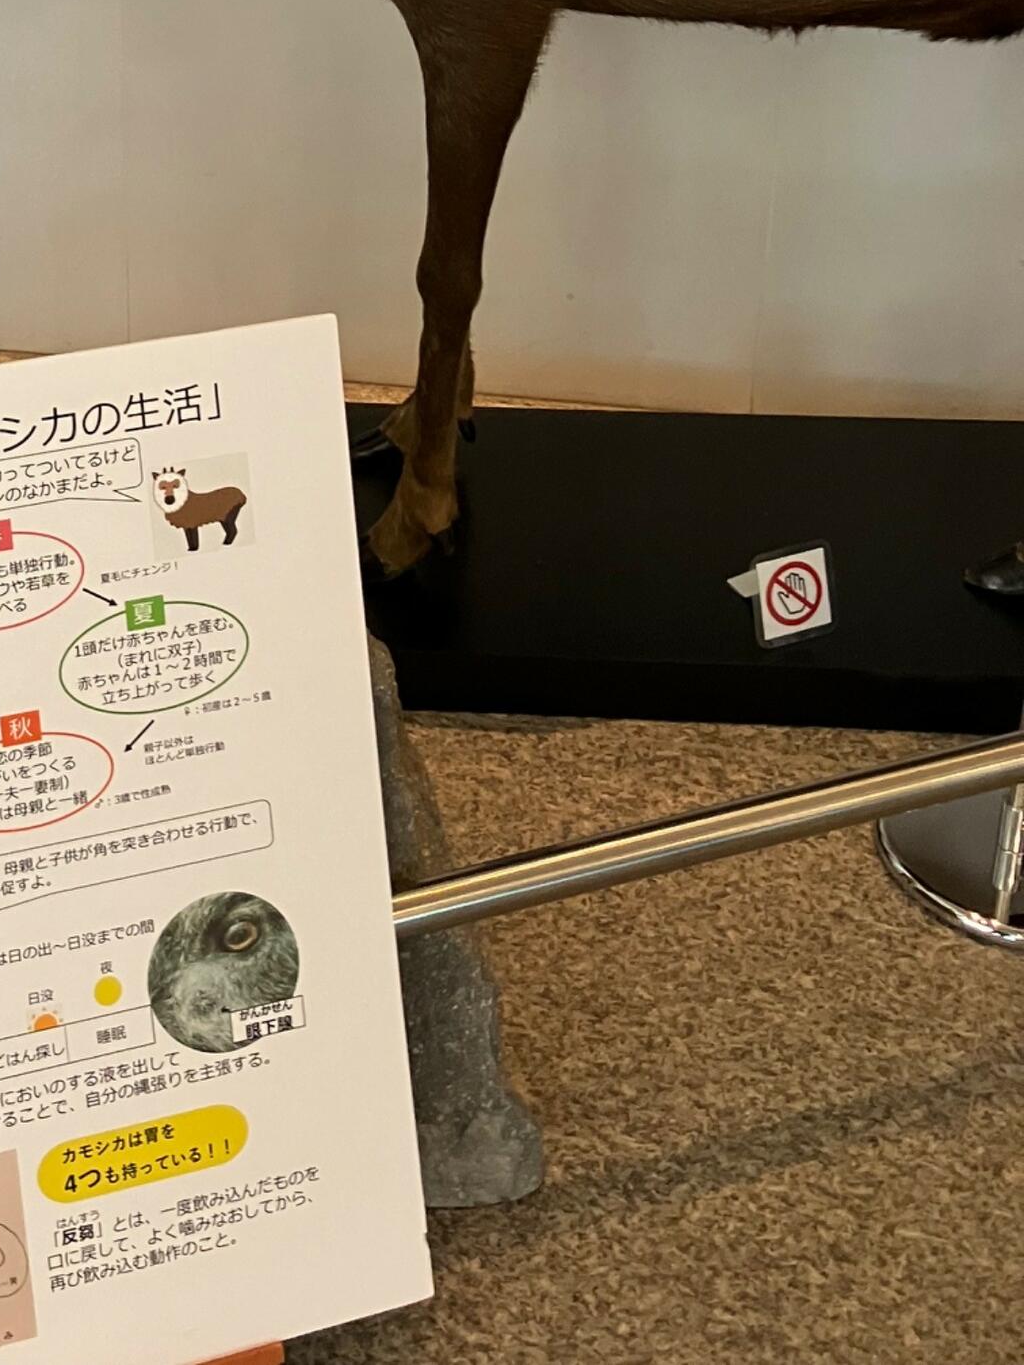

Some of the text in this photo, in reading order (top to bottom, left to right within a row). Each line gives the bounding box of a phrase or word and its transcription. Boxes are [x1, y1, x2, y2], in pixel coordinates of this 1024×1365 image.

[132, 601, 155, 625] 夏
[74, 617, 234, 658] 1頭だけ赤ちゃんを産む。
[102, 670, 216, 706] 立ち上がって歩く
[9, 717, 33, 741] 秋
[144, 735, 194, 753] 親子以外は
[145, 741, 225, 766] ほとんど単独行動
[100, 960, 114, 974] 夜
[28, 988, 54, 1005] 日没
[239, 1000, 294, 1022] がんかせん
[96, 1024, 127, 1045] 睡眠
[62, 1123, 176, 1164] カモシカは胃を
[53, 1166, 320, 1248] 「反芻」とは、一度飲み込んだものを
[47, 1190, 313, 1271] 口に戻して、よく噛みなおしてから、
[56, 1209, 100, 1230] はんすう
[49, 1234, 237, 1293] 再び飲み込む動作のこと。
